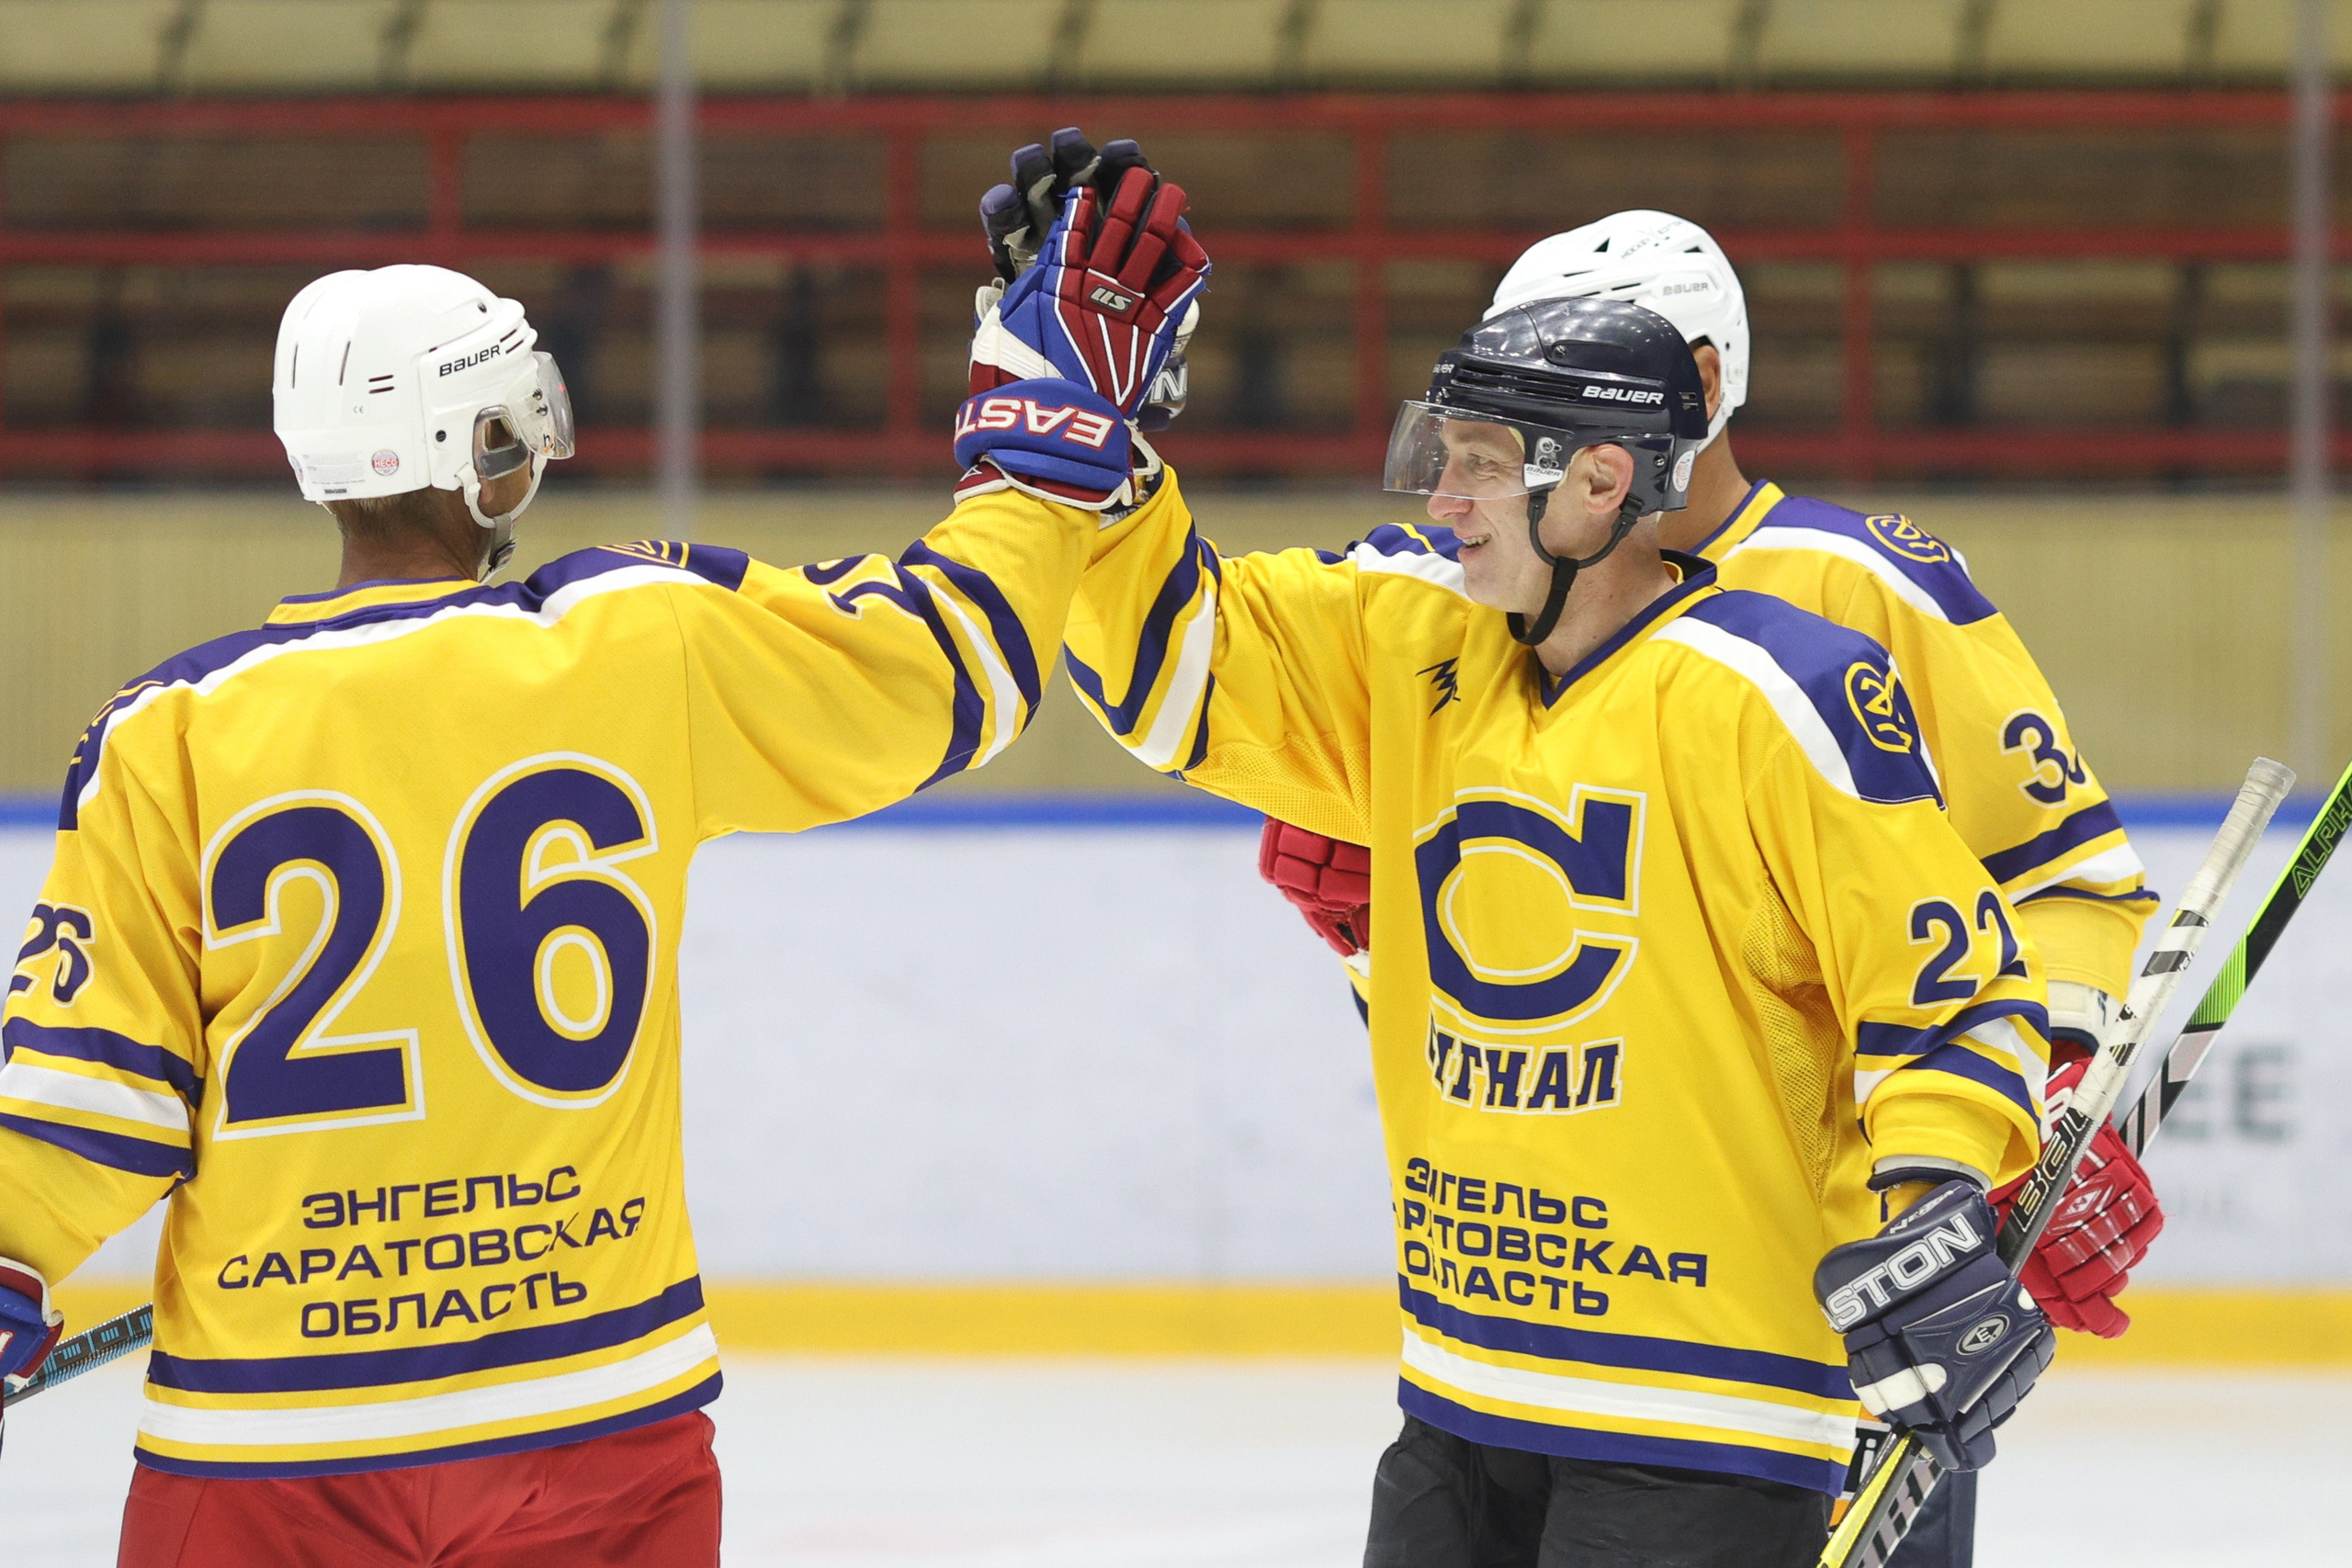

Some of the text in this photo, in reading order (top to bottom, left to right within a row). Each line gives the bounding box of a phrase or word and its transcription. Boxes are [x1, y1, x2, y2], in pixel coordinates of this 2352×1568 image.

[1662, 282, 1710, 296] BAUER
[438, 344, 502, 378] BAUER
[955, 395, 1117, 451] EAST
[1581, 384, 1664, 406] BAUER
[1526, 466, 1561, 477] BAUER
[198, 750, 660, 1143] 26
[1905, 885, 2032, 1010] 22
[301, 1165, 582, 1229] ЭНГЕЛЬС
[217, 1196, 647, 1290] САРАТОВСКАЯ
[300, 1270, 589, 1338] ОБЛАСТЬ
[1403, 1239, 1611, 1316] ОЛАСТЬ
